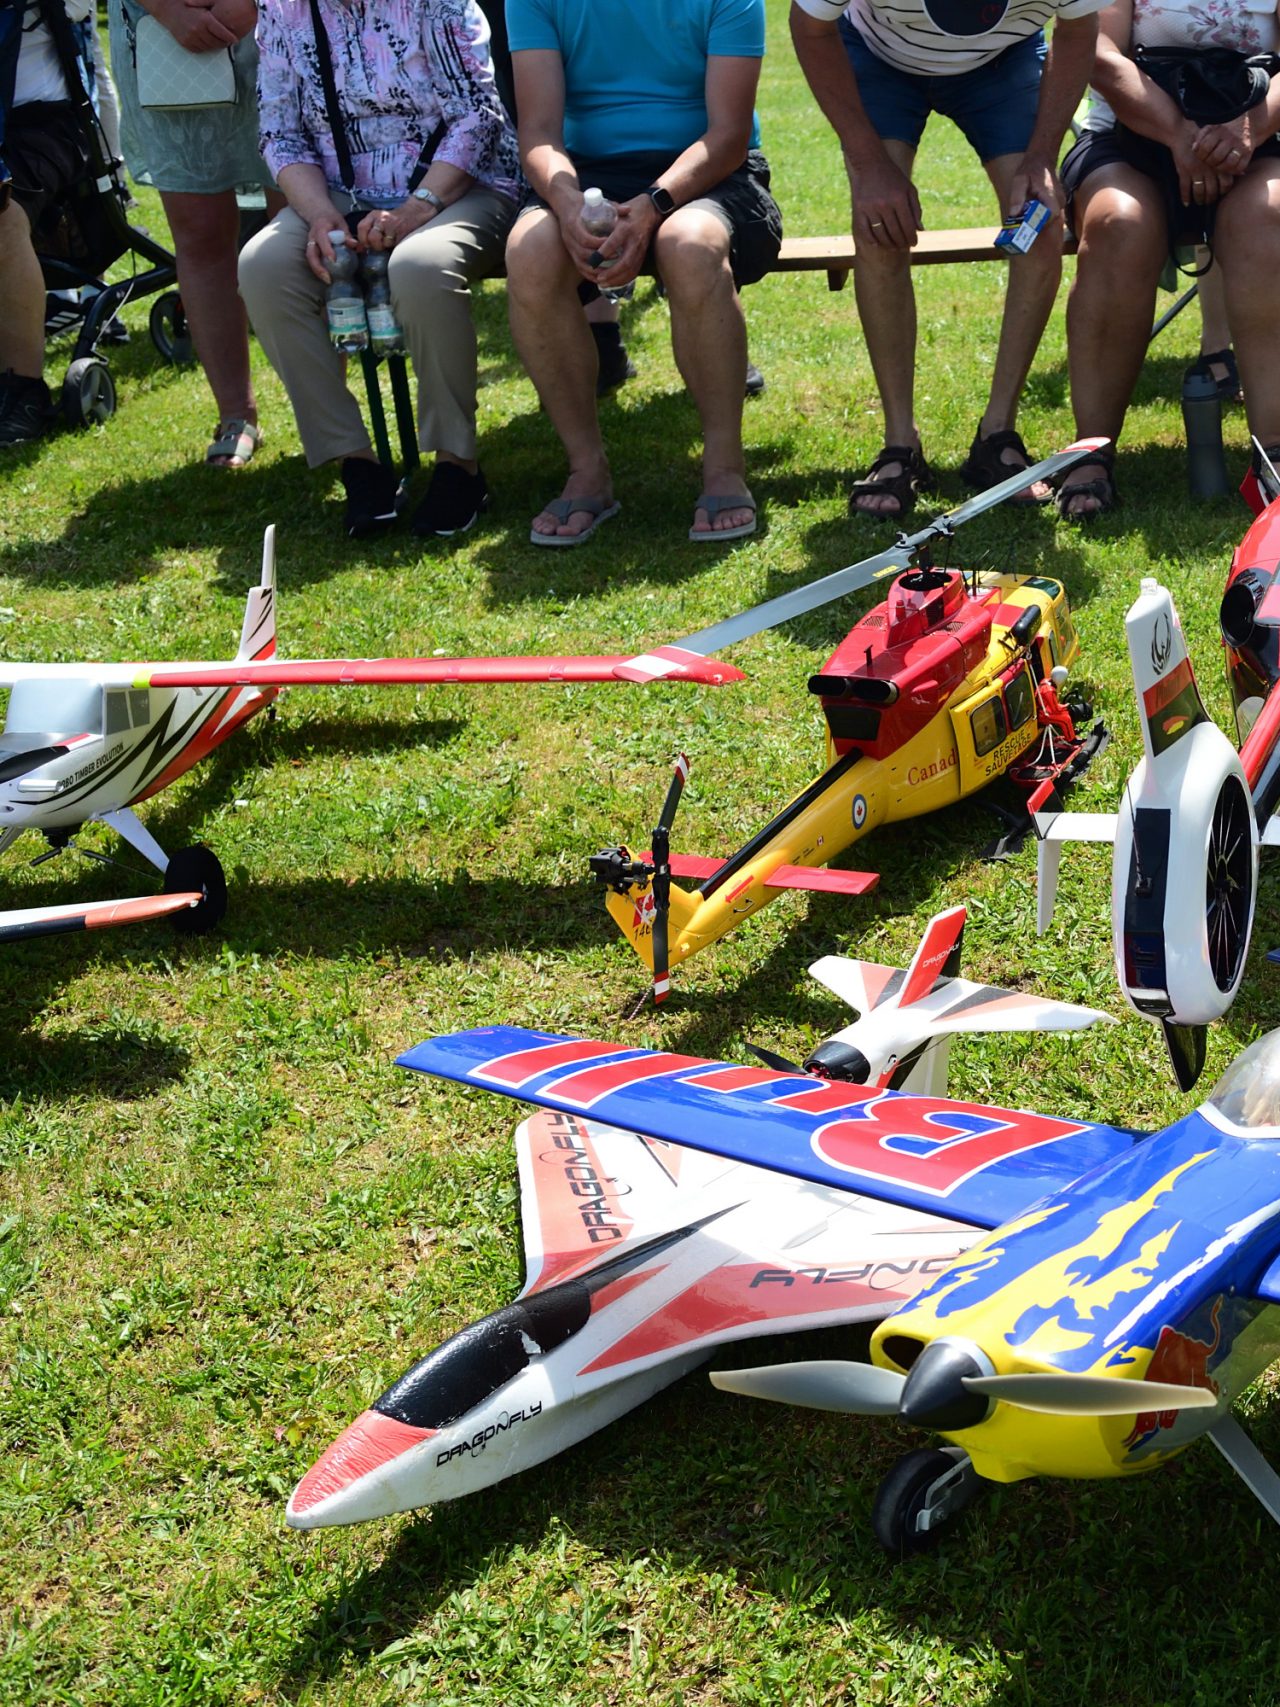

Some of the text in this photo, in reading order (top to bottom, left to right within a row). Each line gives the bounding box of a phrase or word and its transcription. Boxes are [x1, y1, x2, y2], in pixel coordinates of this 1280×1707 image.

[74, 762, 96, 784] TIMBER
[96, 742, 124, 768] EVOLUTION
[985, 734, 1032, 776] SAUVETAGE
[993, 729, 1025, 760] RESCUE
[908, 748, 957, 786] Canad
[466, 1040, 1096, 1197] Bull
[541, 1112, 624, 1243] DRAGONFLY
[437, 1400, 542, 1467] DRAGONFLY
